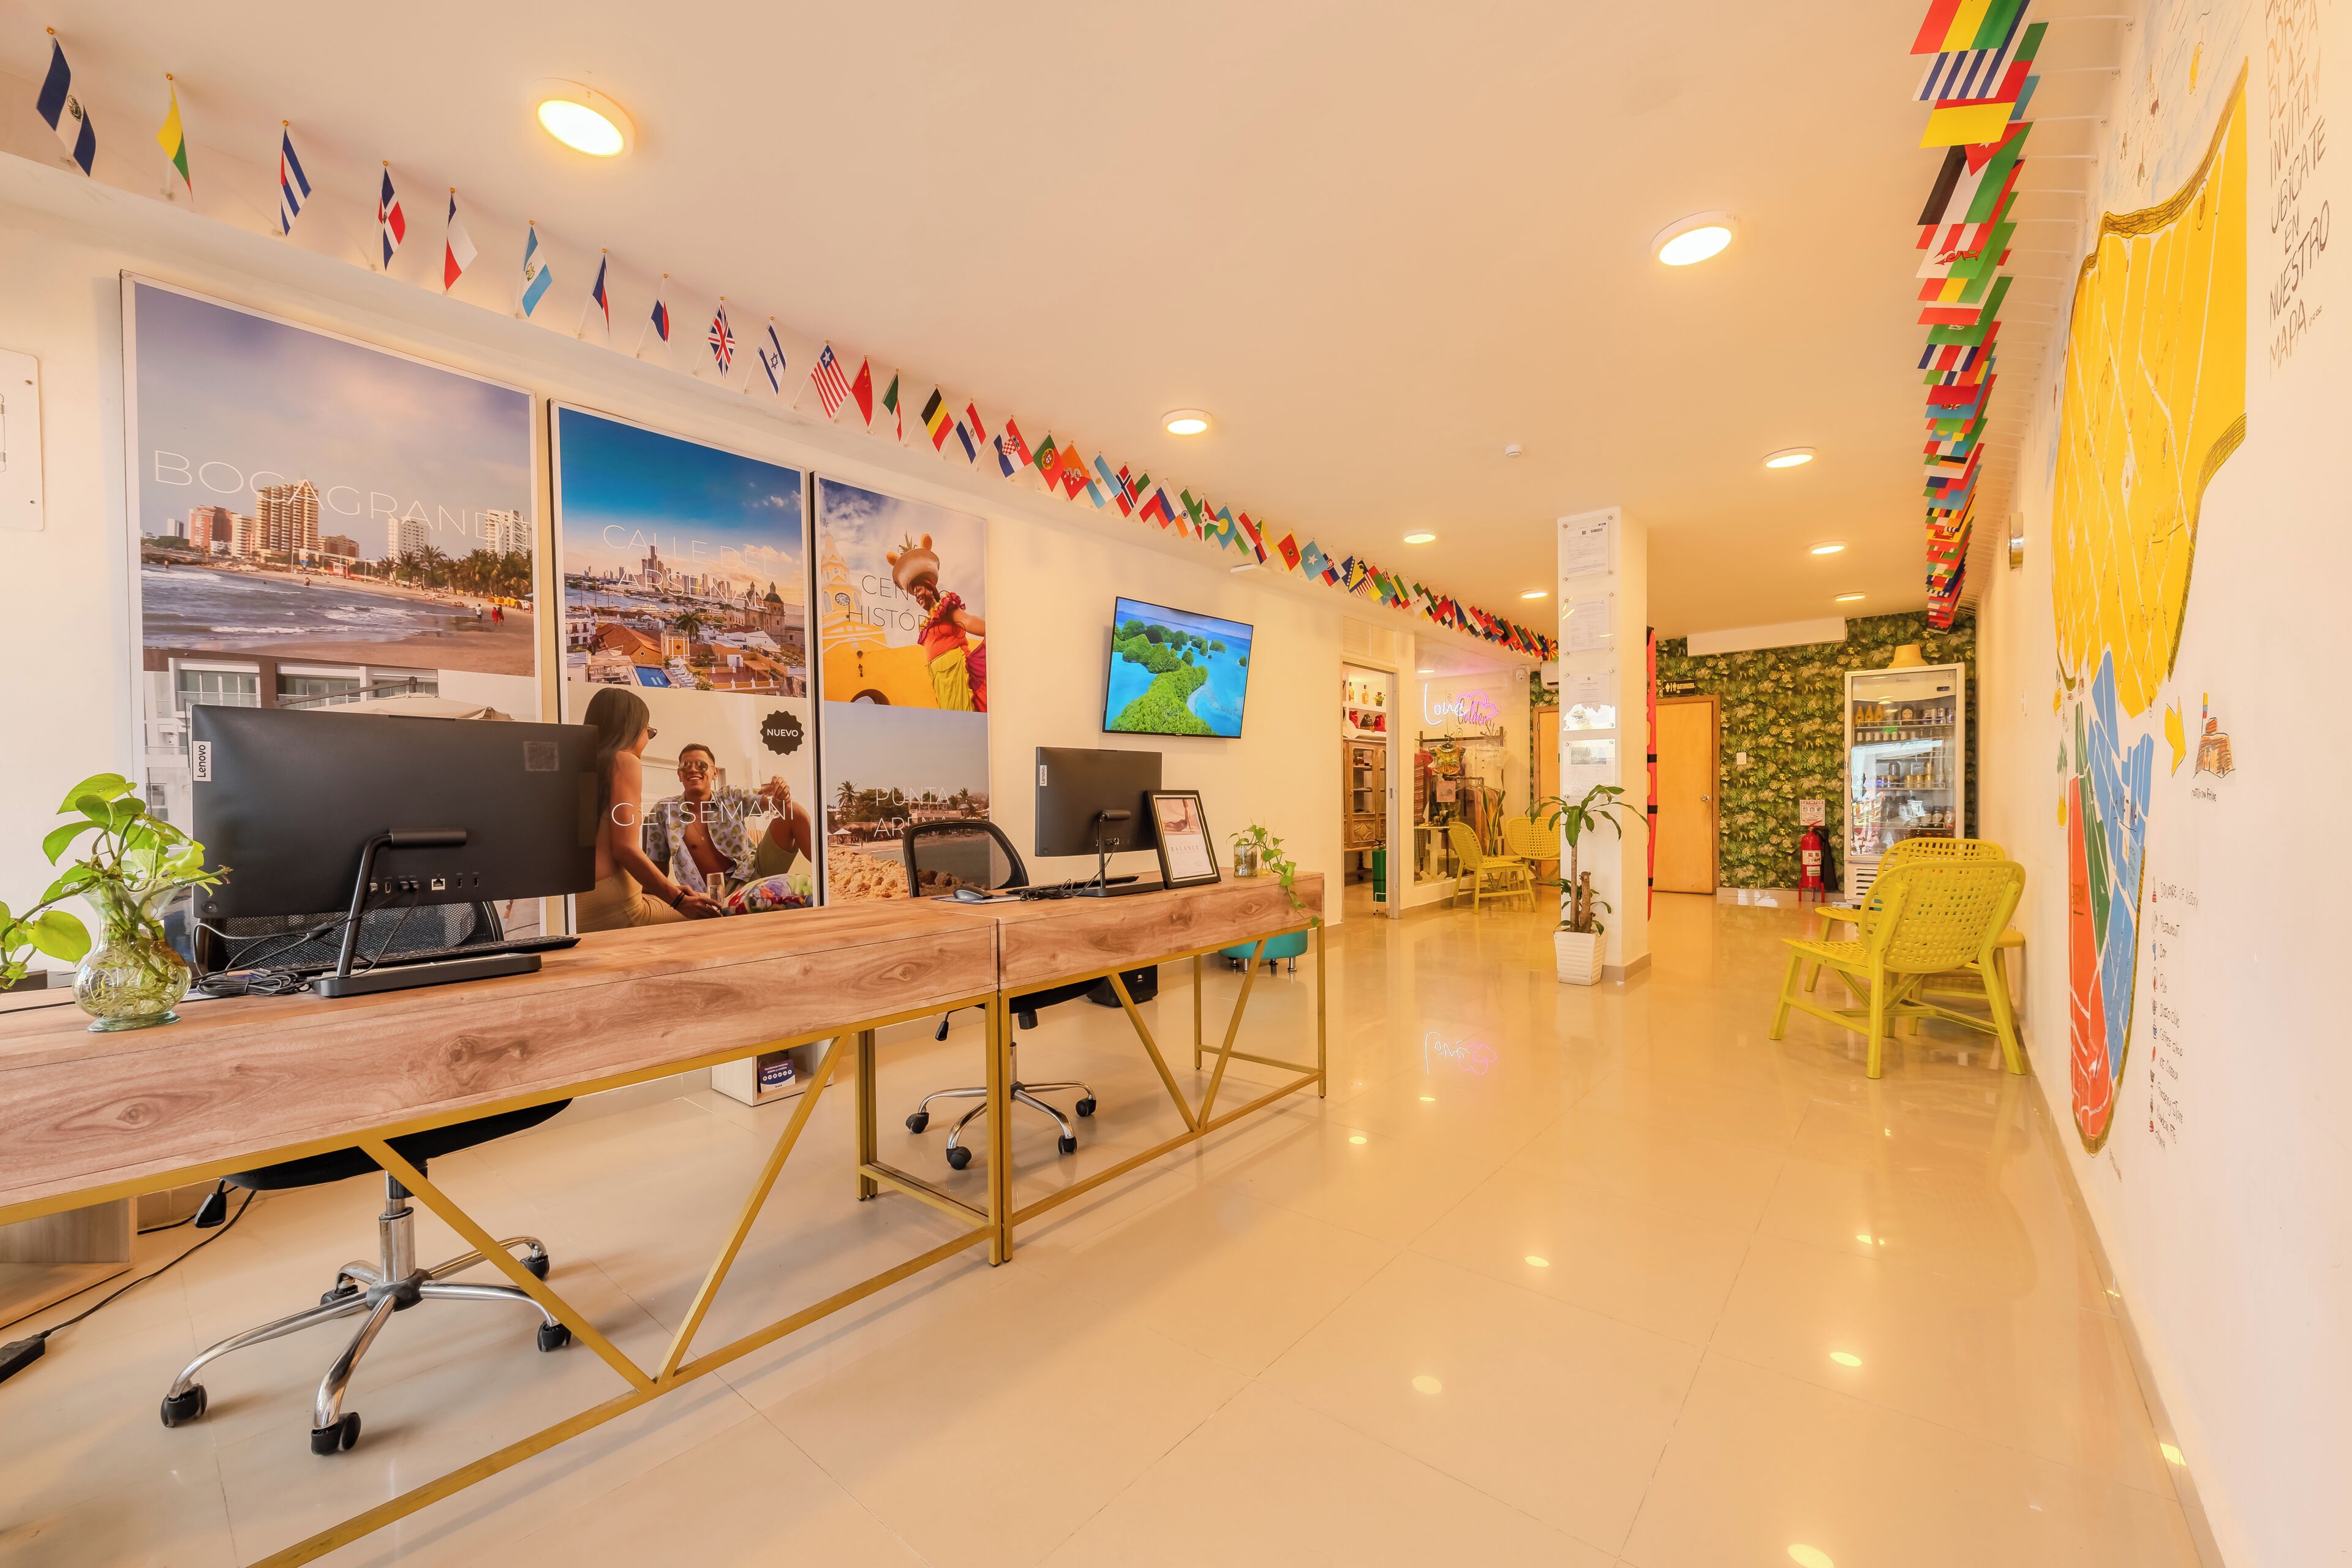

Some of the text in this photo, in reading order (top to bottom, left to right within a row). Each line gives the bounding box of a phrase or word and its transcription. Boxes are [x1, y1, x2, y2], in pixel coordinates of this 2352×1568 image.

[2270, 72, 2310, 187] INVITA
[2285, 204, 2300, 255] EN
[2269, 199, 2330, 328] NUESTRO
[154, 449, 532, 548] BOCAGRANDE
[603, 524, 778, 577] CALLE DEL
[617, 566, 768, 609] ARSENAL
[1424, 683, 1469, 725] Love
[766, 728, 799, 737] NUEVO
[1483, 722, 1507, 742] Stoe
[198, 744, 207, 778] Lenovo
[876, 786, 951, 807] PUNTA
